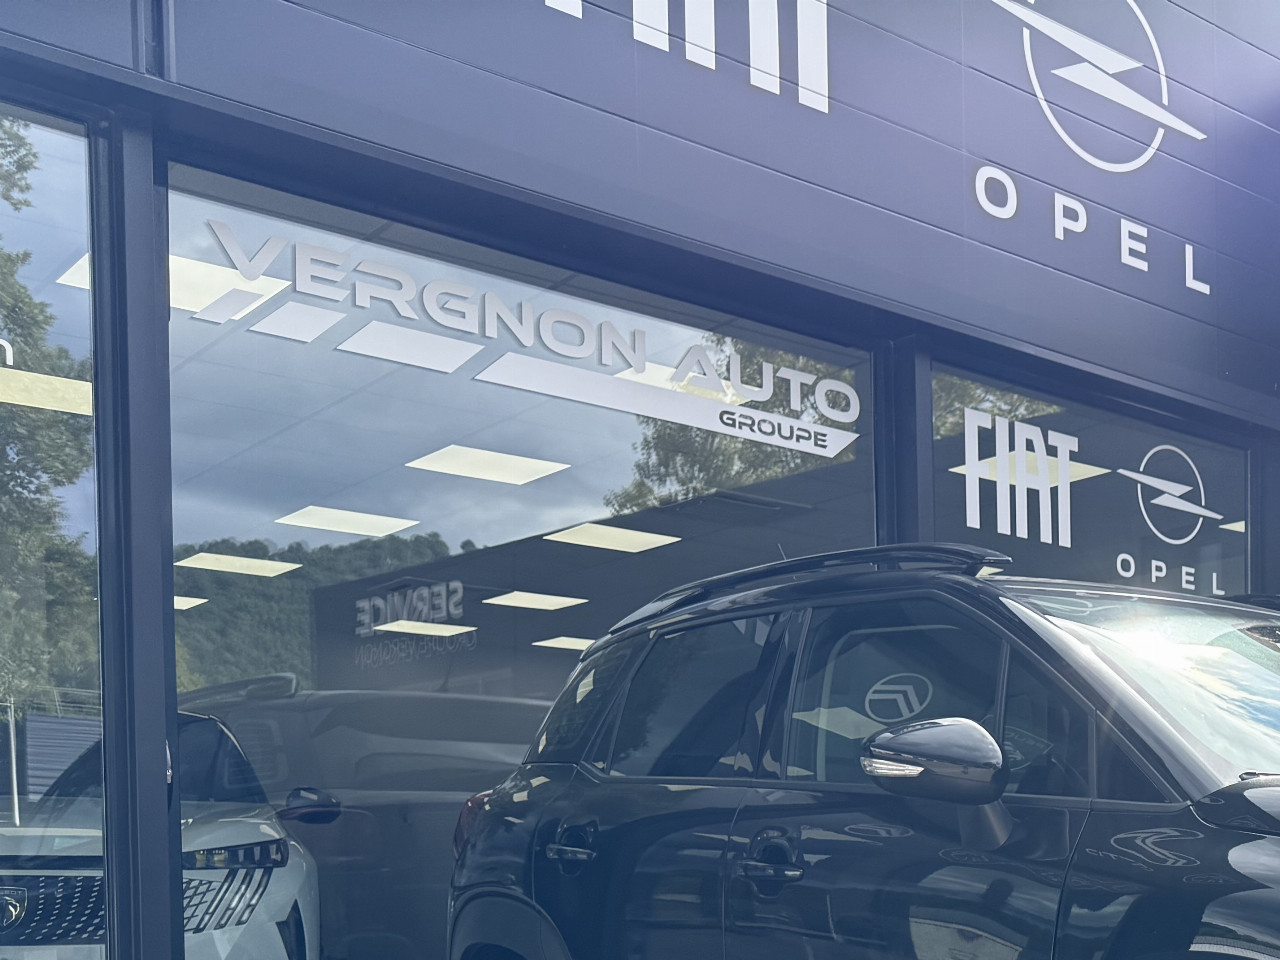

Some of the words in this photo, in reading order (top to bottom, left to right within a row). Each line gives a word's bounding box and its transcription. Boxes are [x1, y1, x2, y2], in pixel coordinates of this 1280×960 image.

[975, 165, 1211, 296] OPEL
[207, 218, 647, 374] VERGNON
[670, 343, 861, 424] AUTO
[718, 410, 829, 450] GROUPE
[964, 407, 1080, 549] FIAT
[1116, 553, 1226, 596] OPEL
